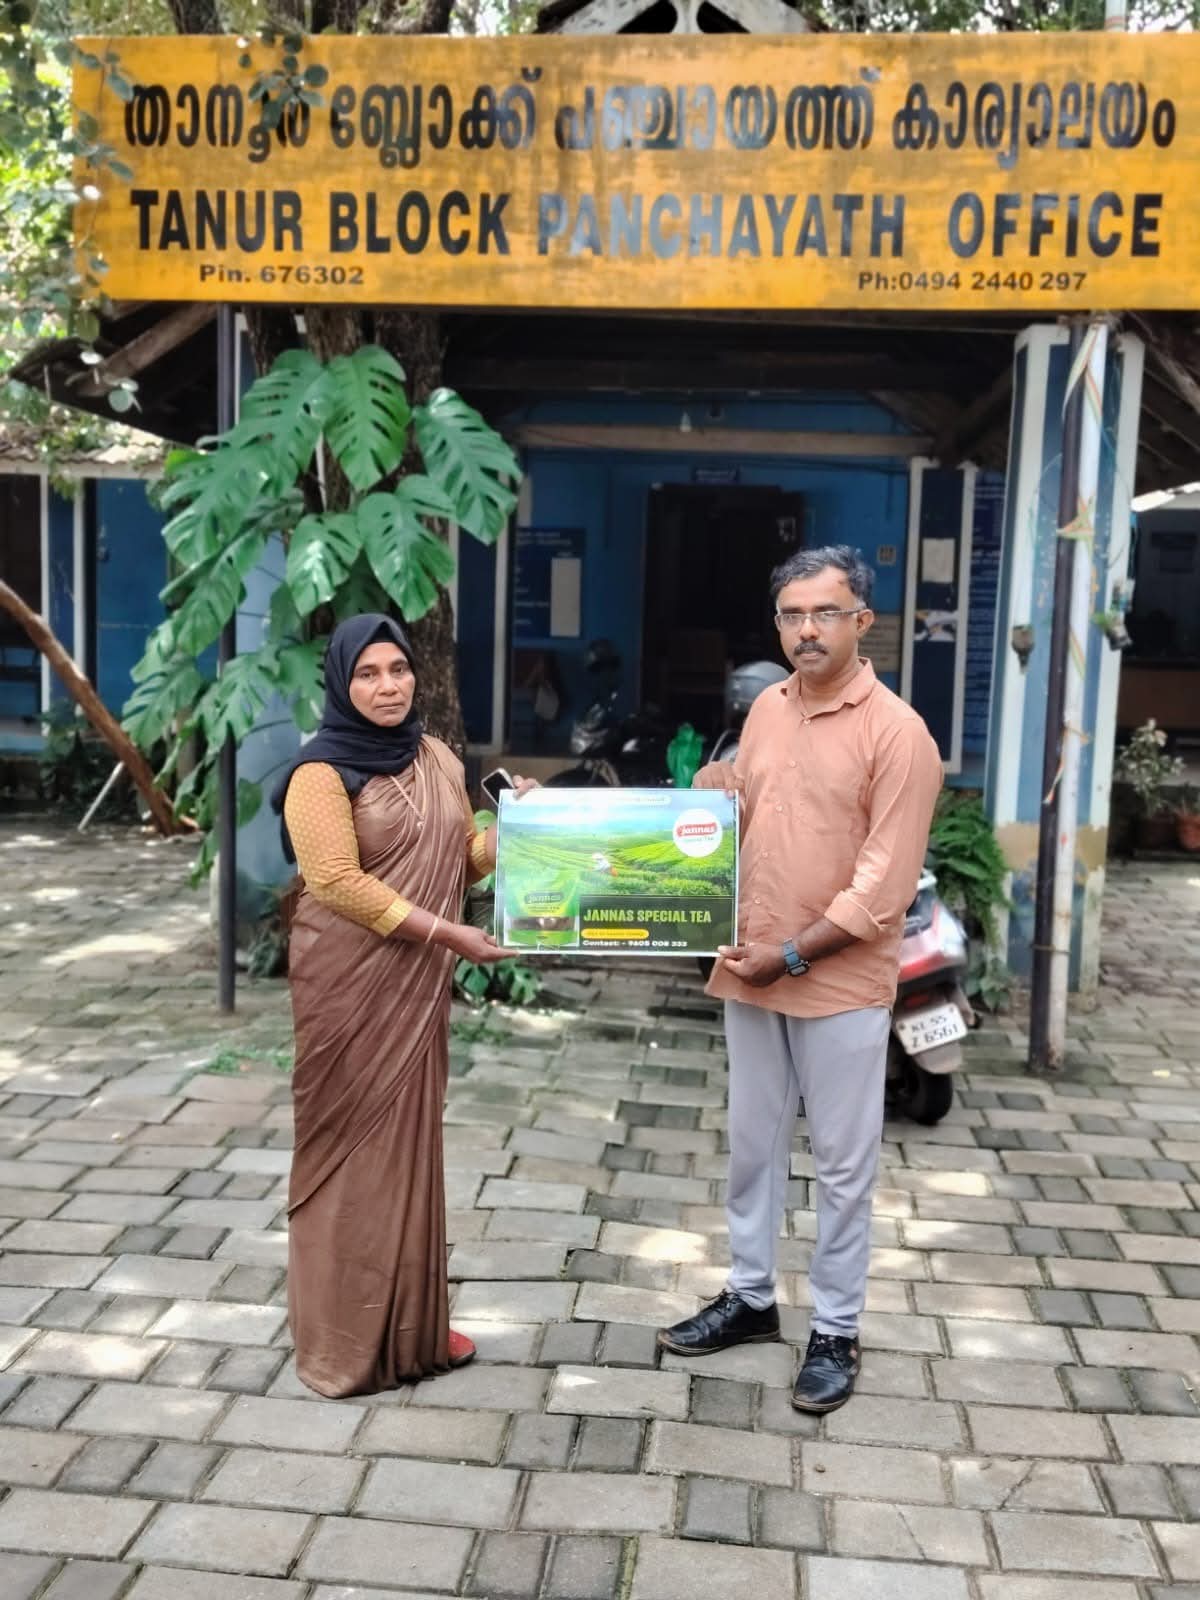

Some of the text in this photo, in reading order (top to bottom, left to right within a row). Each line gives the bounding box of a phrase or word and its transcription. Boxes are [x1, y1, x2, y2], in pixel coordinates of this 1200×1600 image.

[554, 67, 882, 150] പഞ്ചായത്ത്
[893, 81, 1176, 170] കാര്യാലയം
[131, 189, 1163, 258] TANUR BLOCK PANCHAYATH OFFICE
[200, 264, 364, 285] Pin. 676302
[858, 271, 1087, 291] Ph:0494 2440 297
[583, 909, 712, 923] JANNAS SPECIAL TEA
